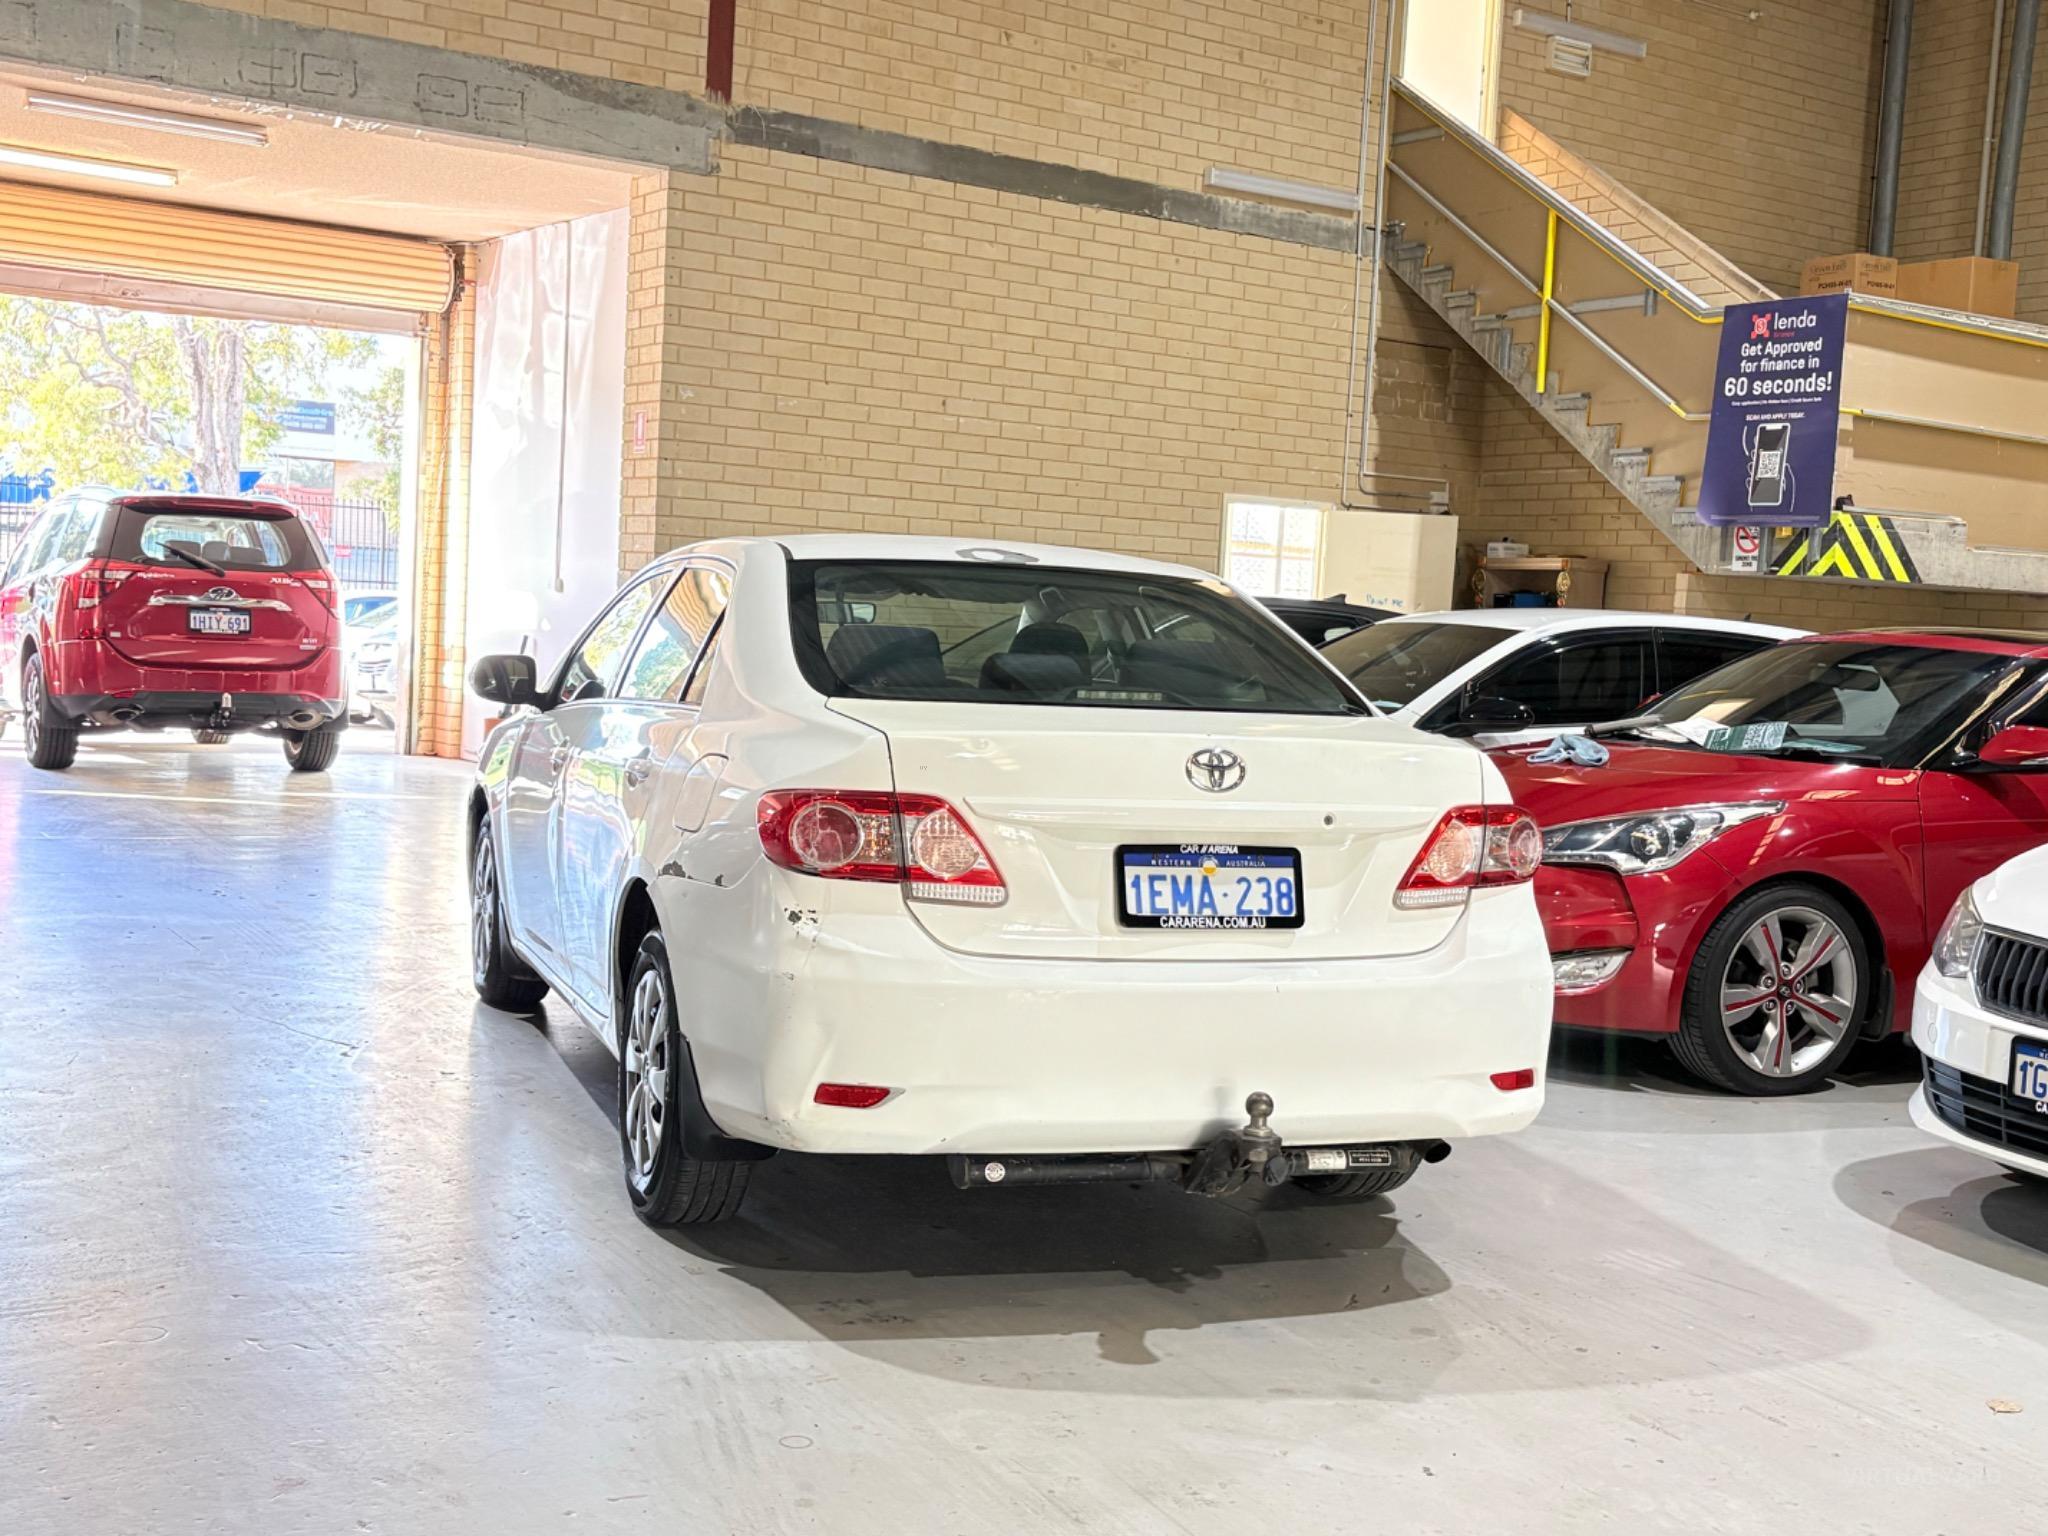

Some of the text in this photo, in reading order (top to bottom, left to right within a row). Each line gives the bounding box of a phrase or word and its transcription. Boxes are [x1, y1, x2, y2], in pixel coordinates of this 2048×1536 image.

[1774, 309, 1817, 330] lenda
[1741, 337, 1823, 357] Get Approved
[1740, 355, 1820, 373] for finance in
[1724, 371, 1833, 397] 60 seconds!
[1180, 844, 1200, 854] CAR
[1151, 859, 1192, 867] WESTERN
[1160, 916, 1266, 929] CARARENA.COM.AU
